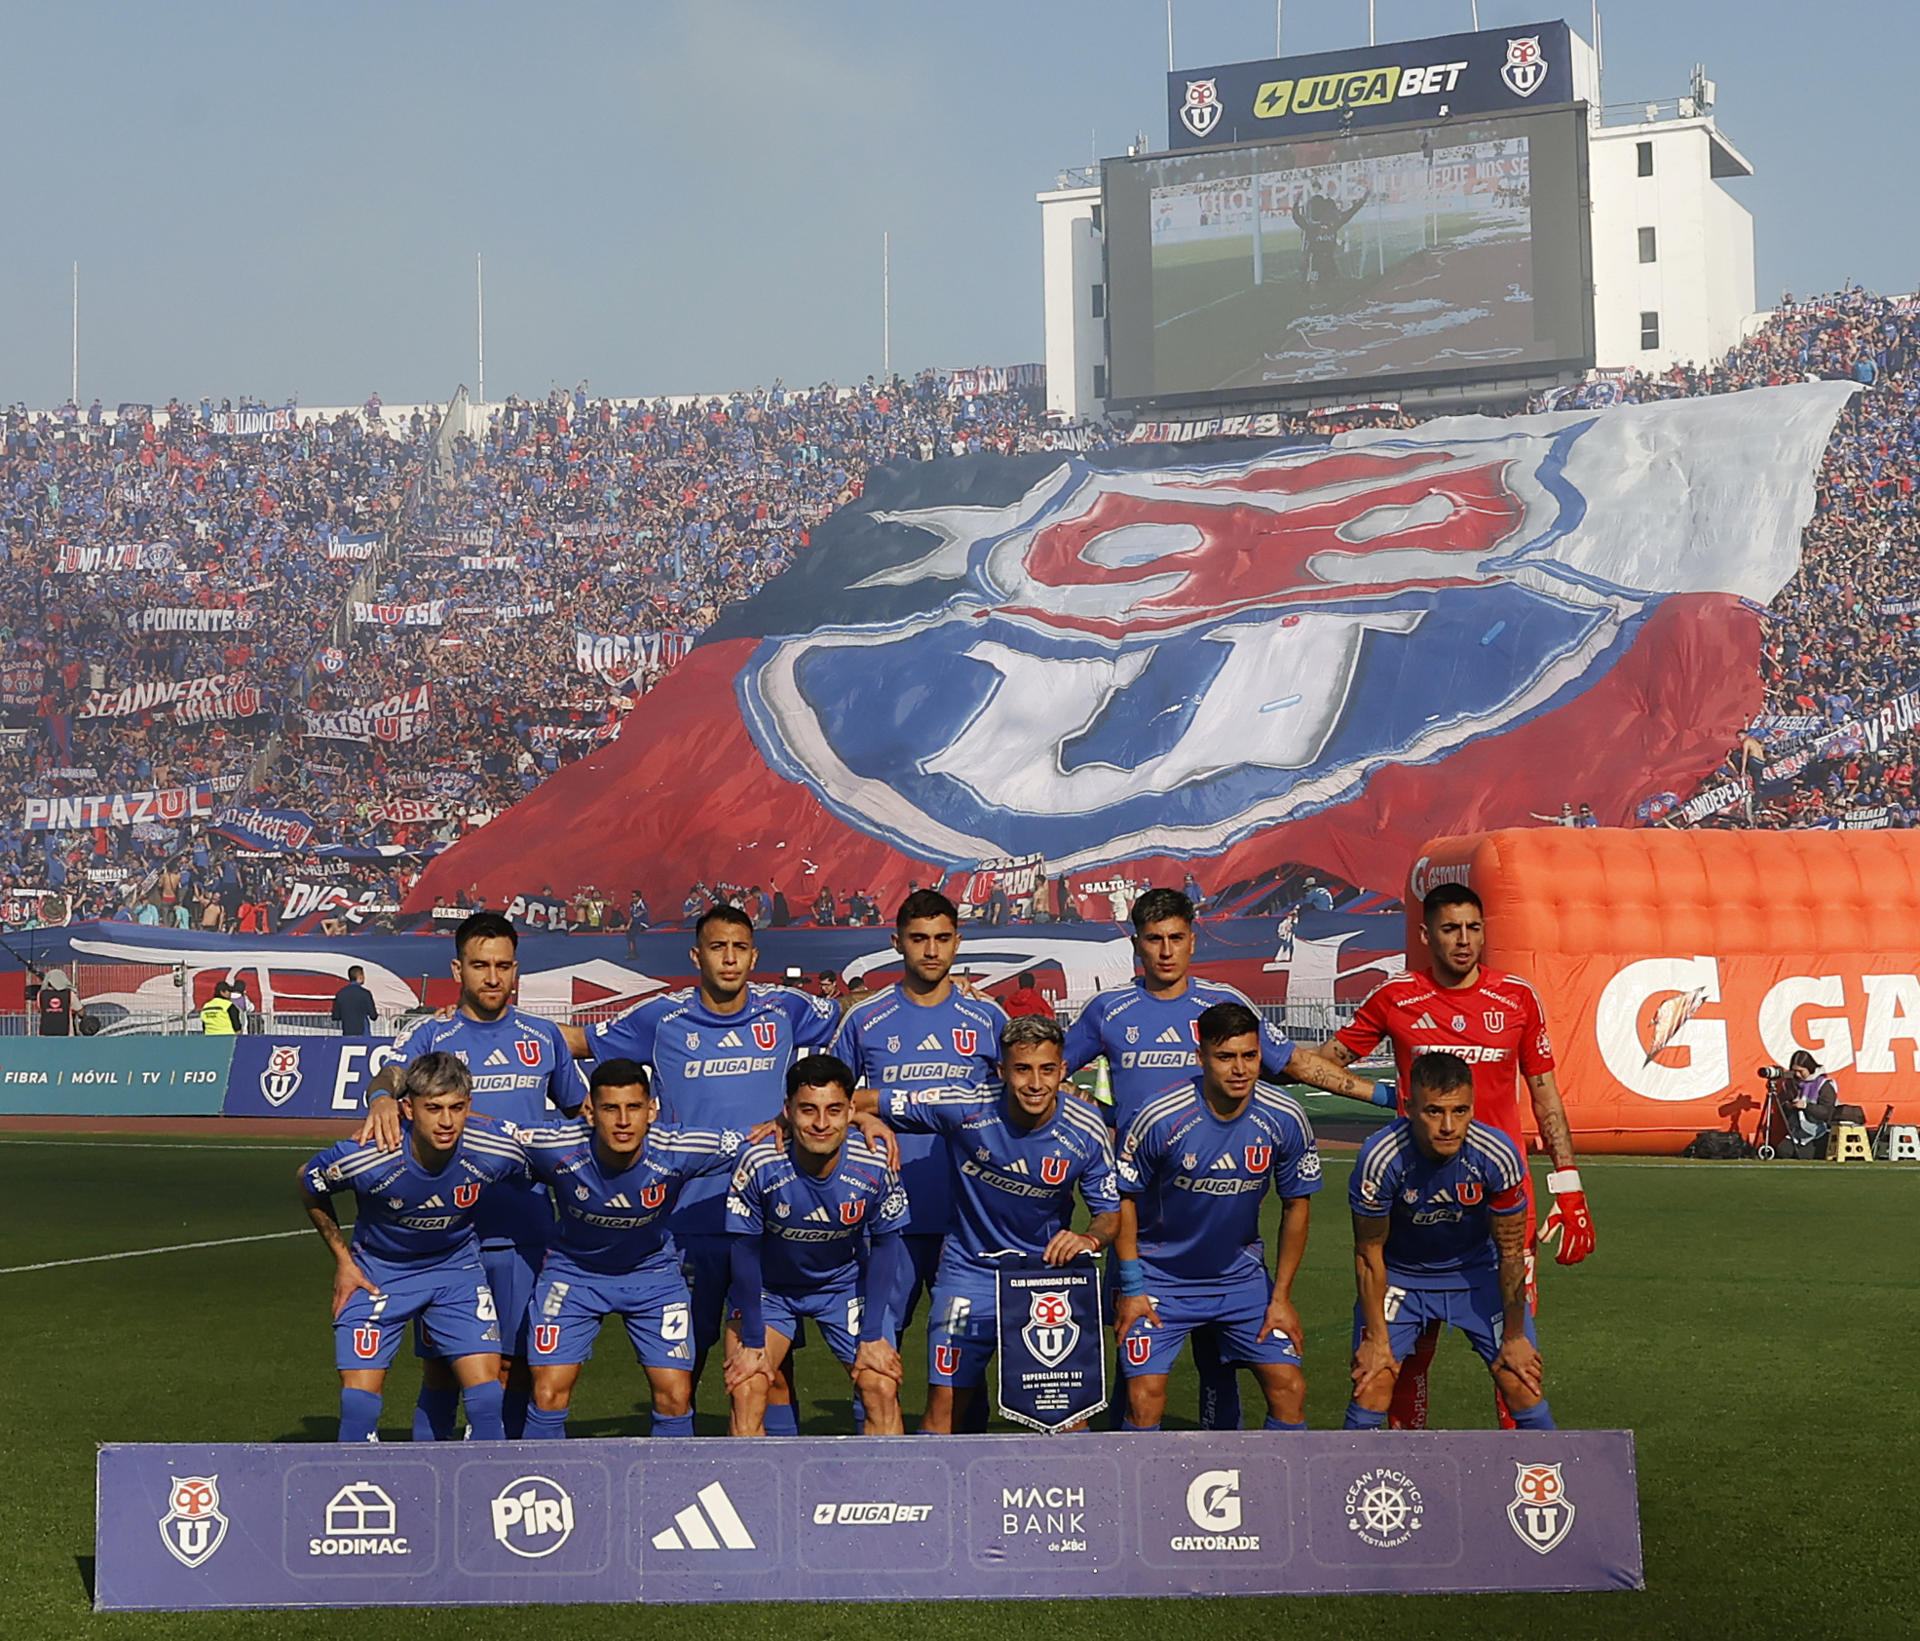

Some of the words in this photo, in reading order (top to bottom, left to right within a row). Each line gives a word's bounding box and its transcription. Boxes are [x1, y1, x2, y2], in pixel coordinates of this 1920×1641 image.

[1298, 62, 1468, 107] JUGABET
[1512, 67, 1536, 88] U
[1190, 107, 1212, 127] U
[143, 607, 235, 632] PONIENTE
[79, 675, 226, 719] SCANNERS
[25, 785, 212, 829] PINTAZUL
[1845, 807, 1888, 820] GERALD
[863, 1004, 900, 1031] MACHBANK
[953, 1002, 991, 1029] MACHBANK
[1483, 1011, 1504, 1033] U
[1596, 955, 1730, 1101] G
[751, 1021, 777, 1051] U
[952, 1028, 978, 1056] U
[514, 1040, 541, 1068] U
[704, 1057, 776, 1076] JUGABET
[5, 1071, 49, 1084] FIBRA
[71, 1069, 118, 1084] MÓVIL
[142, 1072, 161, 1083] TV
[183, 1071, 217, 1083] FIJO
[473, 1074, 543, 1091] JUGABET
[902, 1063, 974, 1081] JUGABET
[1041, 1157, 1070, 1185] U
[1245, 1145, 1272, 1173] U
[454, 1183, 480, 1208] U
[640, 1184, 667, 1209] U
[982, 1171, 1060, 1200] JUGABET
[1194, 1175, 1267, 1195] JUGABET
[1456, 1183, 1483, 1205] U
[840, 1199, 866, 1225] U
[1010, 1279, 1026, 1287] CLUB
[1027, 1278, 1063, 1287] UNIVERSIDAD
[1064, 1278, 1071, 1286] DE
[1072, 1277, 1087, 1285] CHILE
[354, 1328, 381, 1359] U
[535, 1324, 561, 1355] U
[1037, 1329, 1065, 1357] U
[1125, 1336, 1151, 1366] U
[935, 1345, 961, 1376] U
[1002, 1487, 1085, 1508] MACH
[1186, 1469, 1242, 1532] G
[1345, 1471, 1374, 1516] OCEAN
[1375, 1468, 1424, 1515] PACIFIC'S
[841, 1504, 933, 1524] JUGABET
[1003, 1513, 1085, 1534] BANK
[1526, 1508, 1558, 1540] U
[177, 1521, 211, 1554] U
[309, 1537, 408, 1556] SODIMAC
[1170, 1535, 1260, 1551] GATORADE
[1357, 1529, 1413, 1548] RESTAURANT
